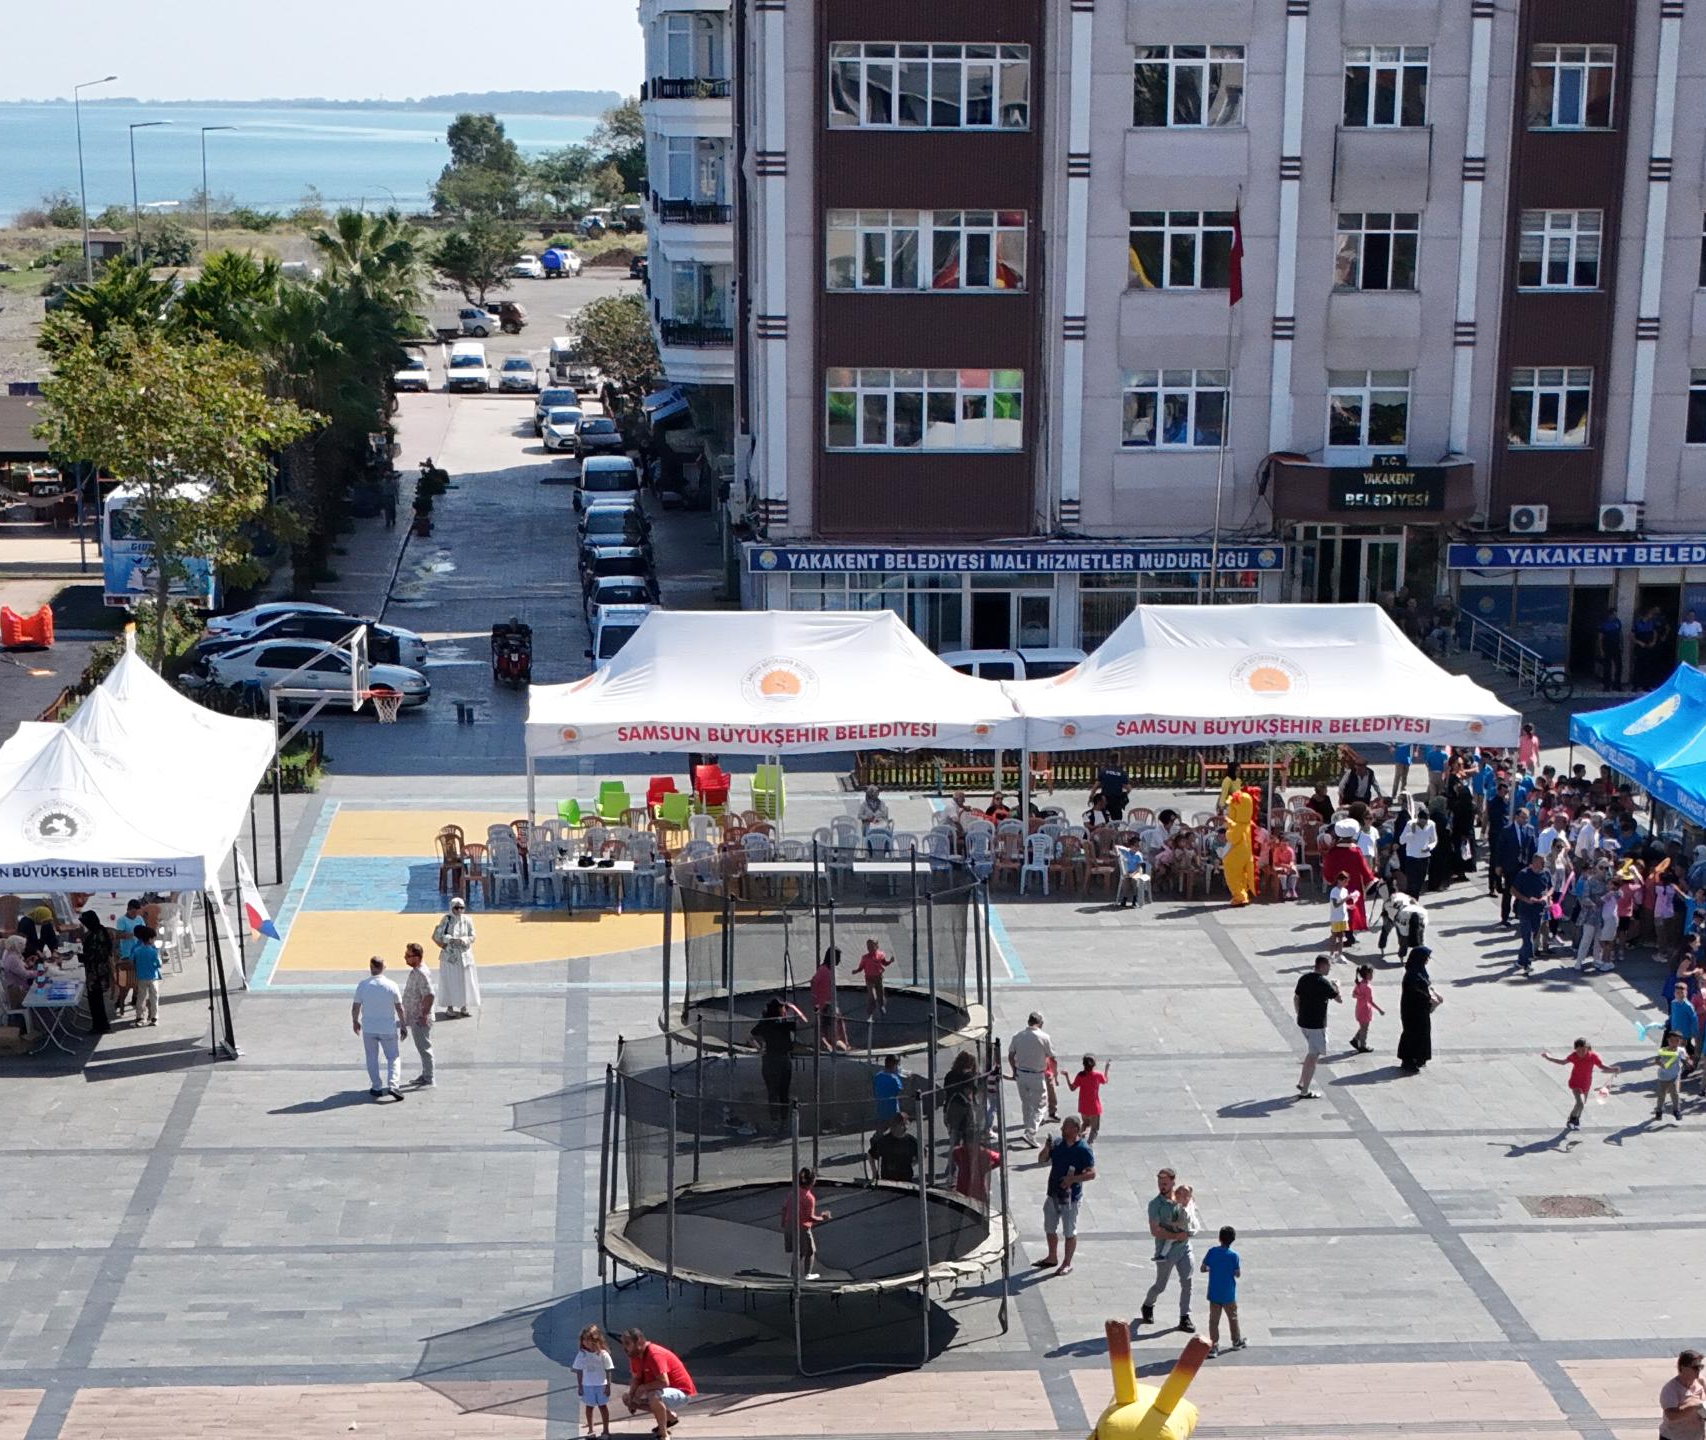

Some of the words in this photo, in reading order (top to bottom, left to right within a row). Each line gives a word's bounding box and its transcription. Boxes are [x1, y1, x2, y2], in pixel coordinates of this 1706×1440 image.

[1363, 473, 1415, 485] YAKAKENT
[1345, 491, 1429, 506] BELEDİYESİ
[787, 554, 879, 570] YAKAKENT
[884, 552, 985, 570] BELEDİYESİ
[990, 552, 1032, 569] MALİ
[1037, 551, 1134, 569] HİZMETLER
[1507, 548, 1628, 565] YAKAKENT
[617, 726, 701, 742] SAMSUN
[707, 724, 829, 748] BÜYÜKŞEHİR
[835, 720, 938, 740] BELEDİYESİ
[1115, 718, 1197, 736] SAMSUN
[1203, 716, 1323, 738] BÜYÜKŞEHİR
[1329, 715, 1431, 735] BELEDİYESİ
[12, 866, 99, 880] BÜYÜKŞEHİR
[103, 864, 176, 878] BELEDİYESİ
